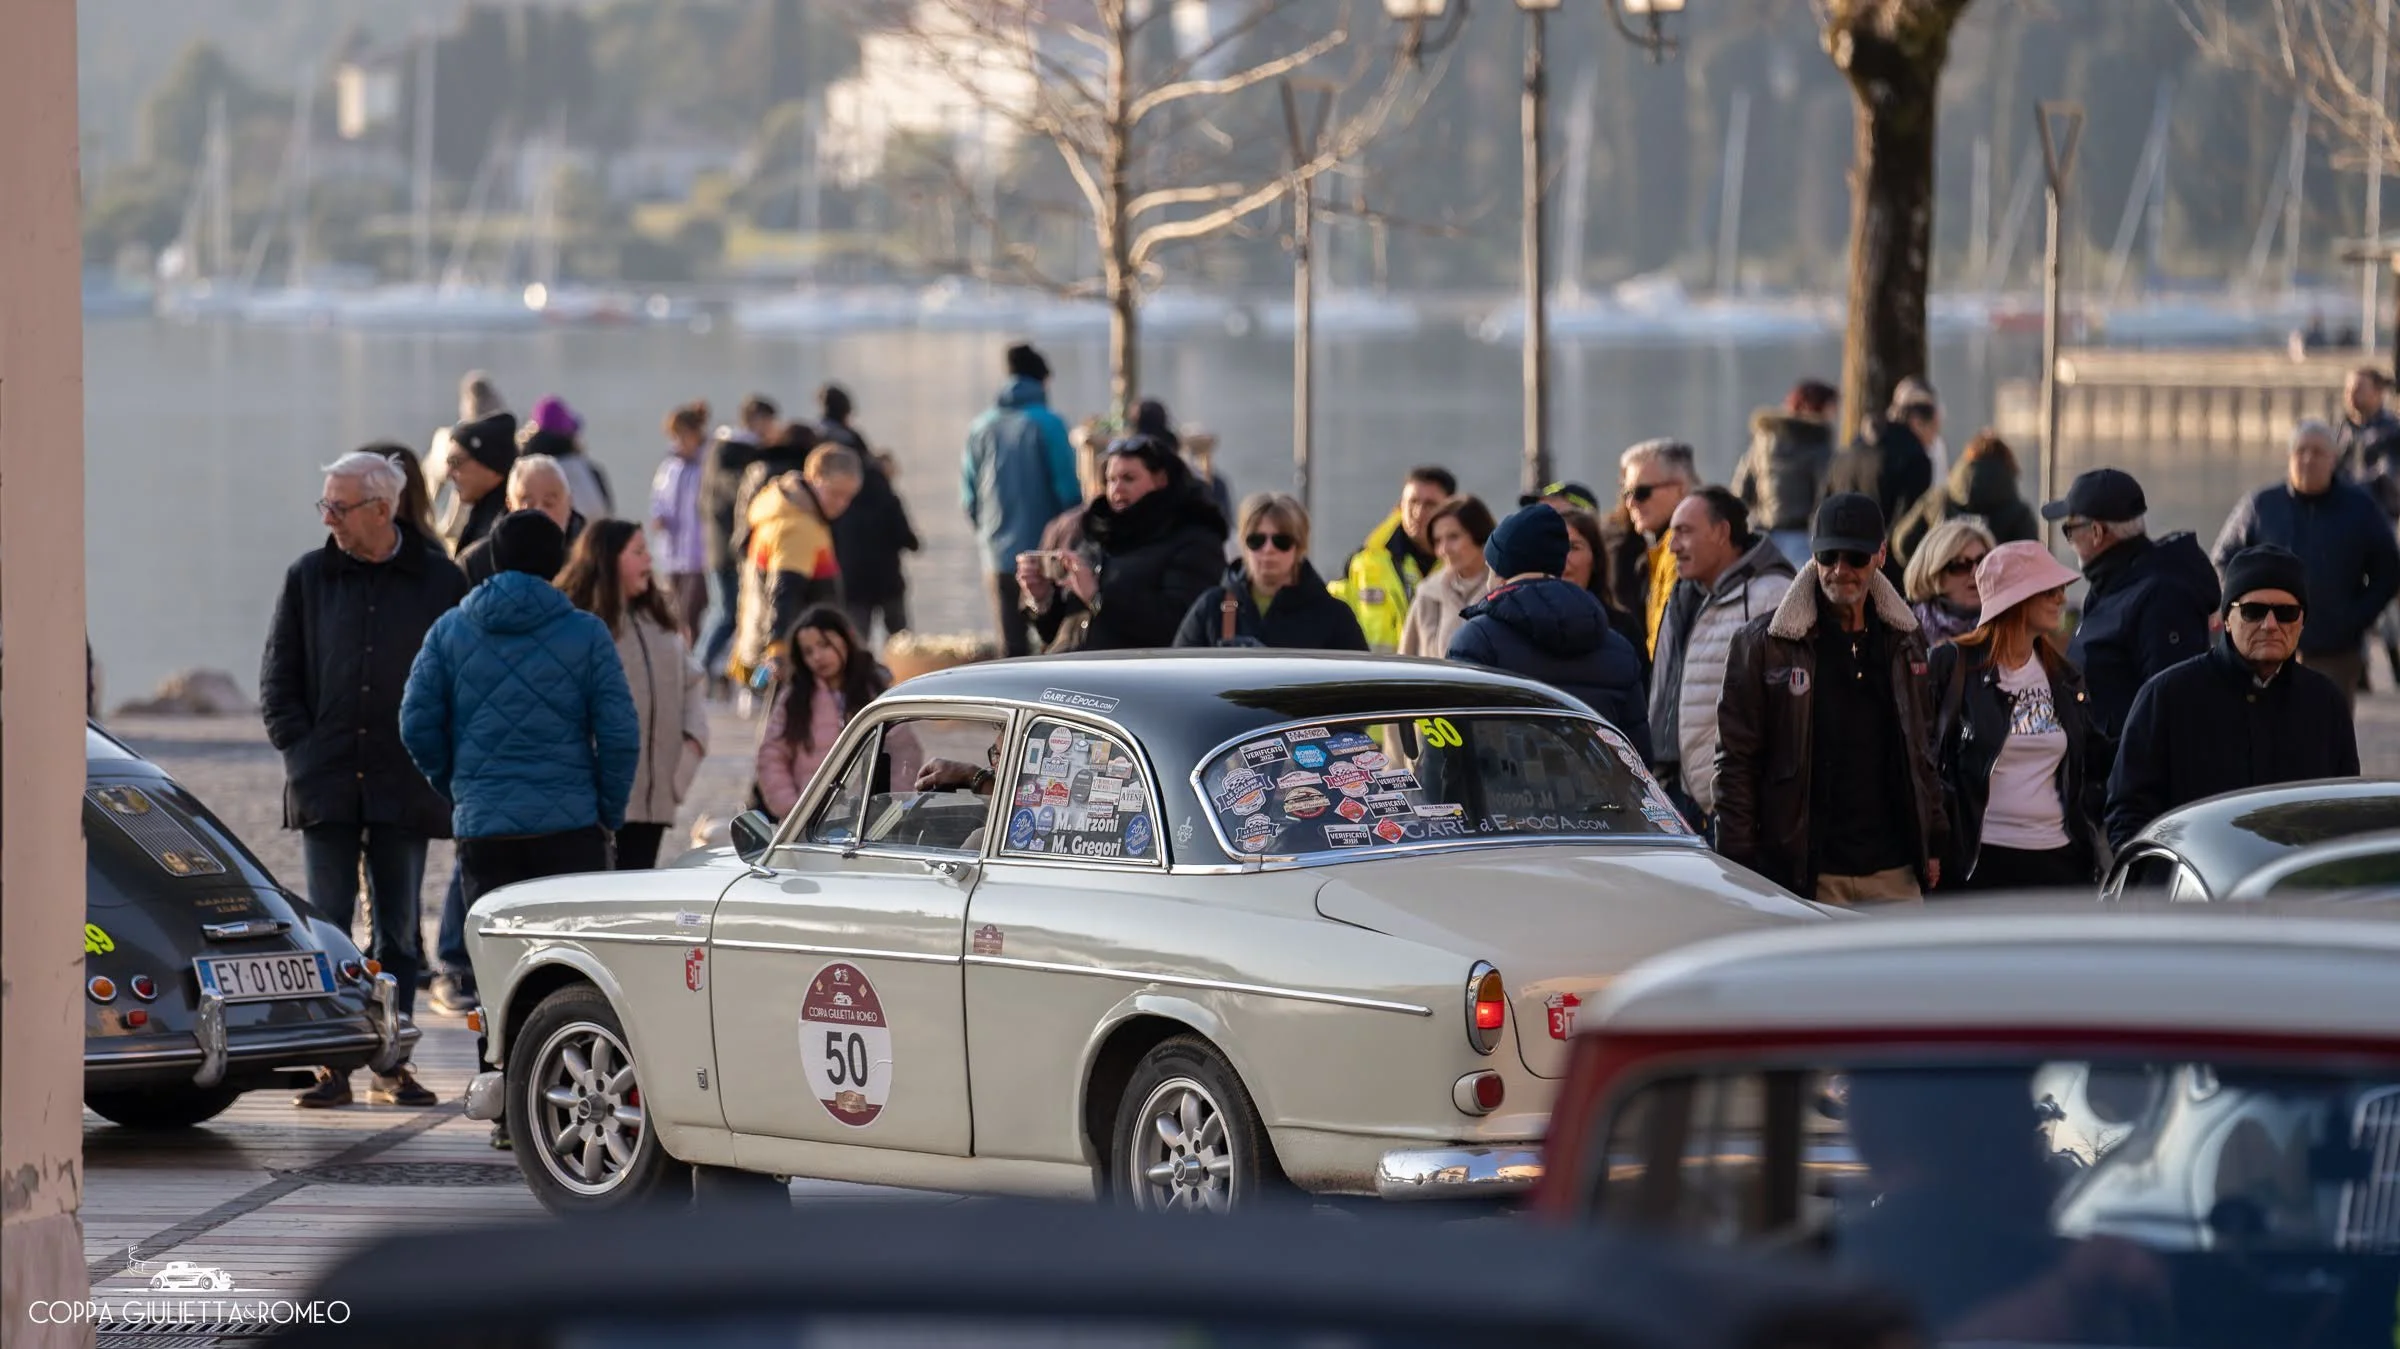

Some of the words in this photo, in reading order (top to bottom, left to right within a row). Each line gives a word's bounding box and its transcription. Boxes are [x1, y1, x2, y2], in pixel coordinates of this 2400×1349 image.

[1043, 690, 1067, 702] GARE
[1414, 717, 1463, 748] 50
[1245, 745, 1283, 760] VERIFICATO
[1234, 778, 1258, 795] COLLINE
[1379, 775, 1413, 785] VERIFICATO
[1236, 781, 1264, 802] GONZAGA
[1370, 800, 1406, 809] VERIFICATO
[1075, 812, 1120, 833] Arzoni
[1330, 832, 1368, 840] VERIFICATO
[1051, 835, 1068, 854] M.
[1071, 835, 1122, 856] Gregori
[808, 1006, 828, 1018] COPPA
[828, 1008, 855, 1020] GIULIETTA
[856, 1010, 878, 1023] ROMEO
[826, 1030, 868, 1088] 50
